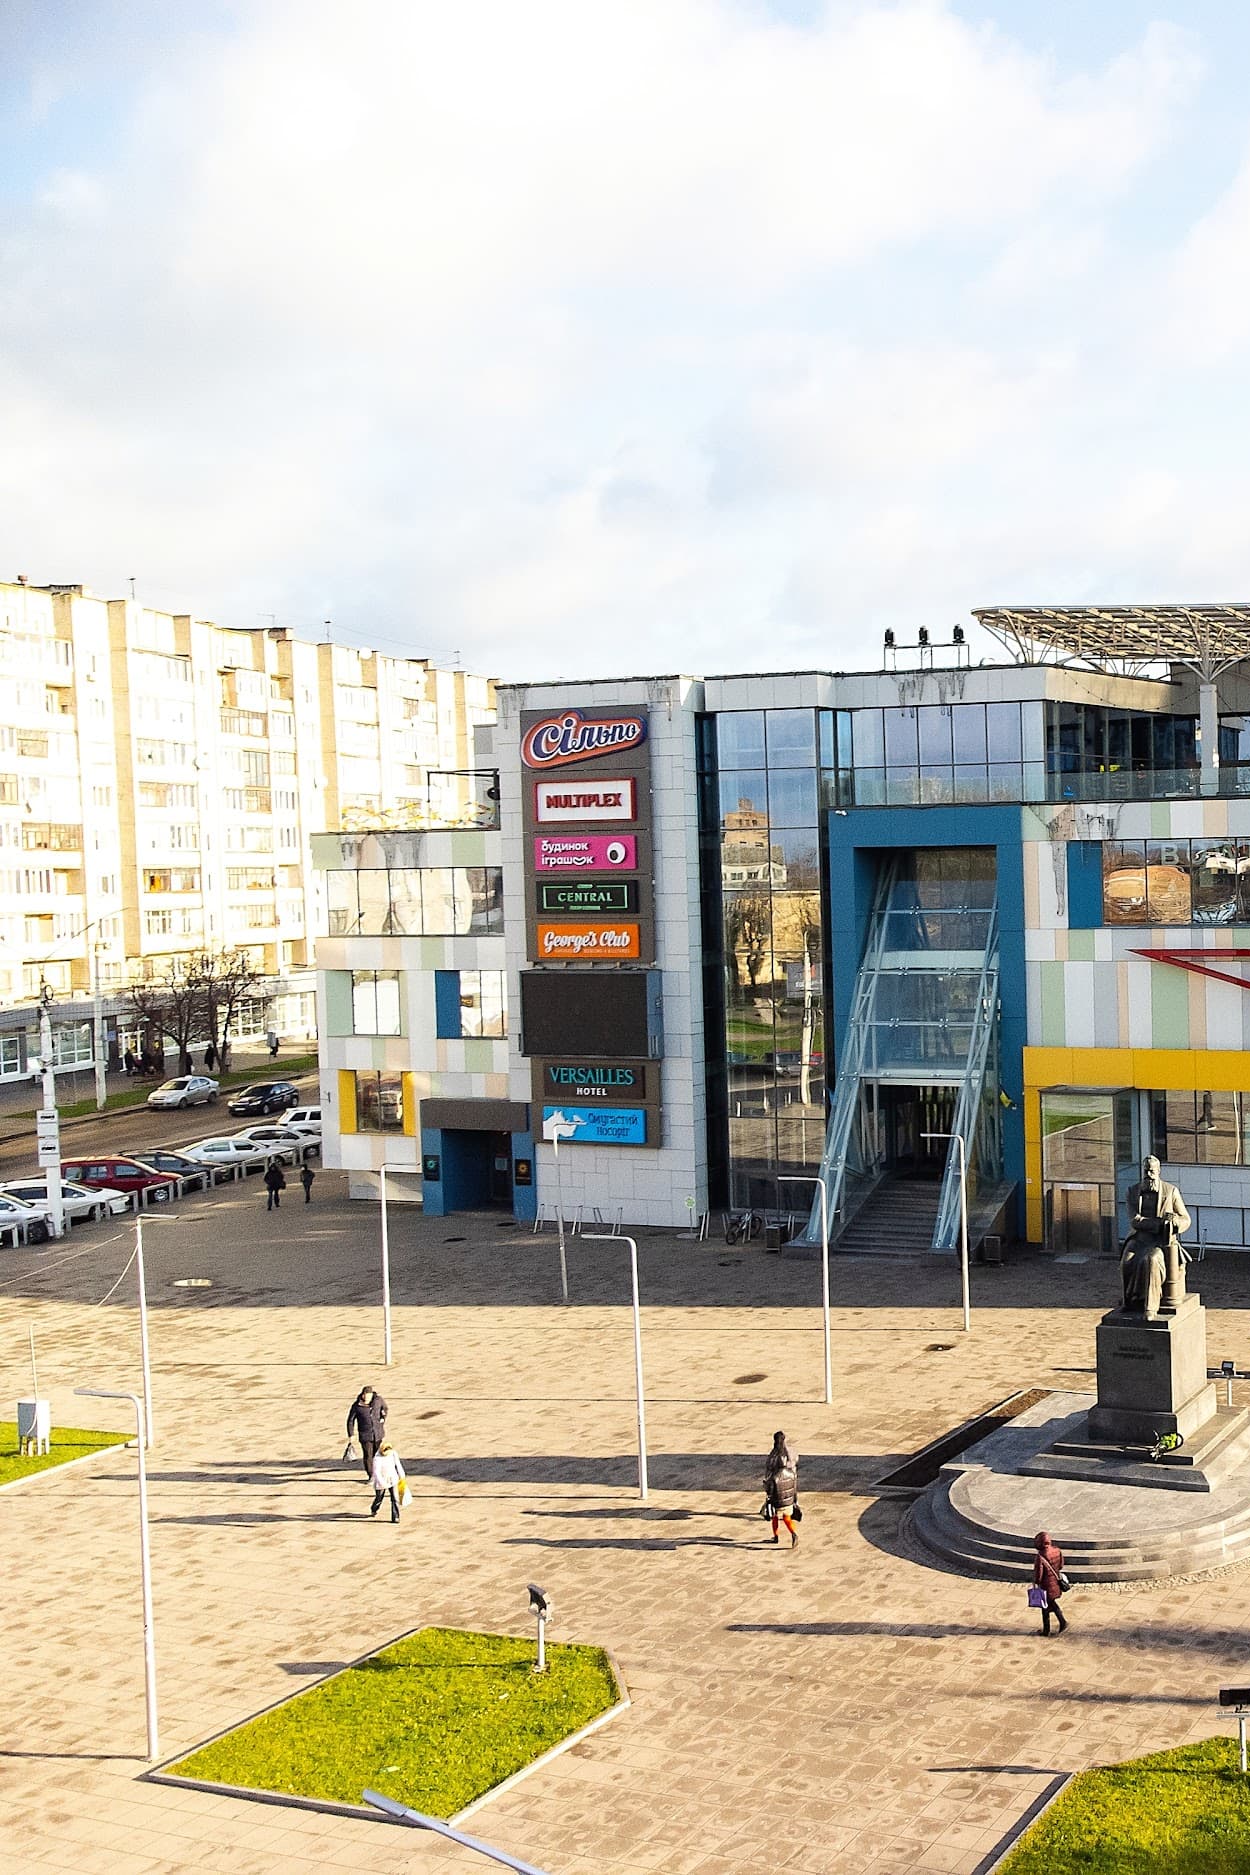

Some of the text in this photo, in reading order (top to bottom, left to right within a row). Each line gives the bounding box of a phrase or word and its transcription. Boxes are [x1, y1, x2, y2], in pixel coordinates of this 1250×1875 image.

[531, 716, 640, 761] Сільпо
[546, 792, 623, 809] MULTIPLEX
[541, 840, 589, 853] будинок
[557, 891, 614, 902] CENTRAL
[599, 930, 631, 947] Club
[550, 1066, 634, 1085] VERSAILLES
[576, 1087, 608, 1097] HOTEL
